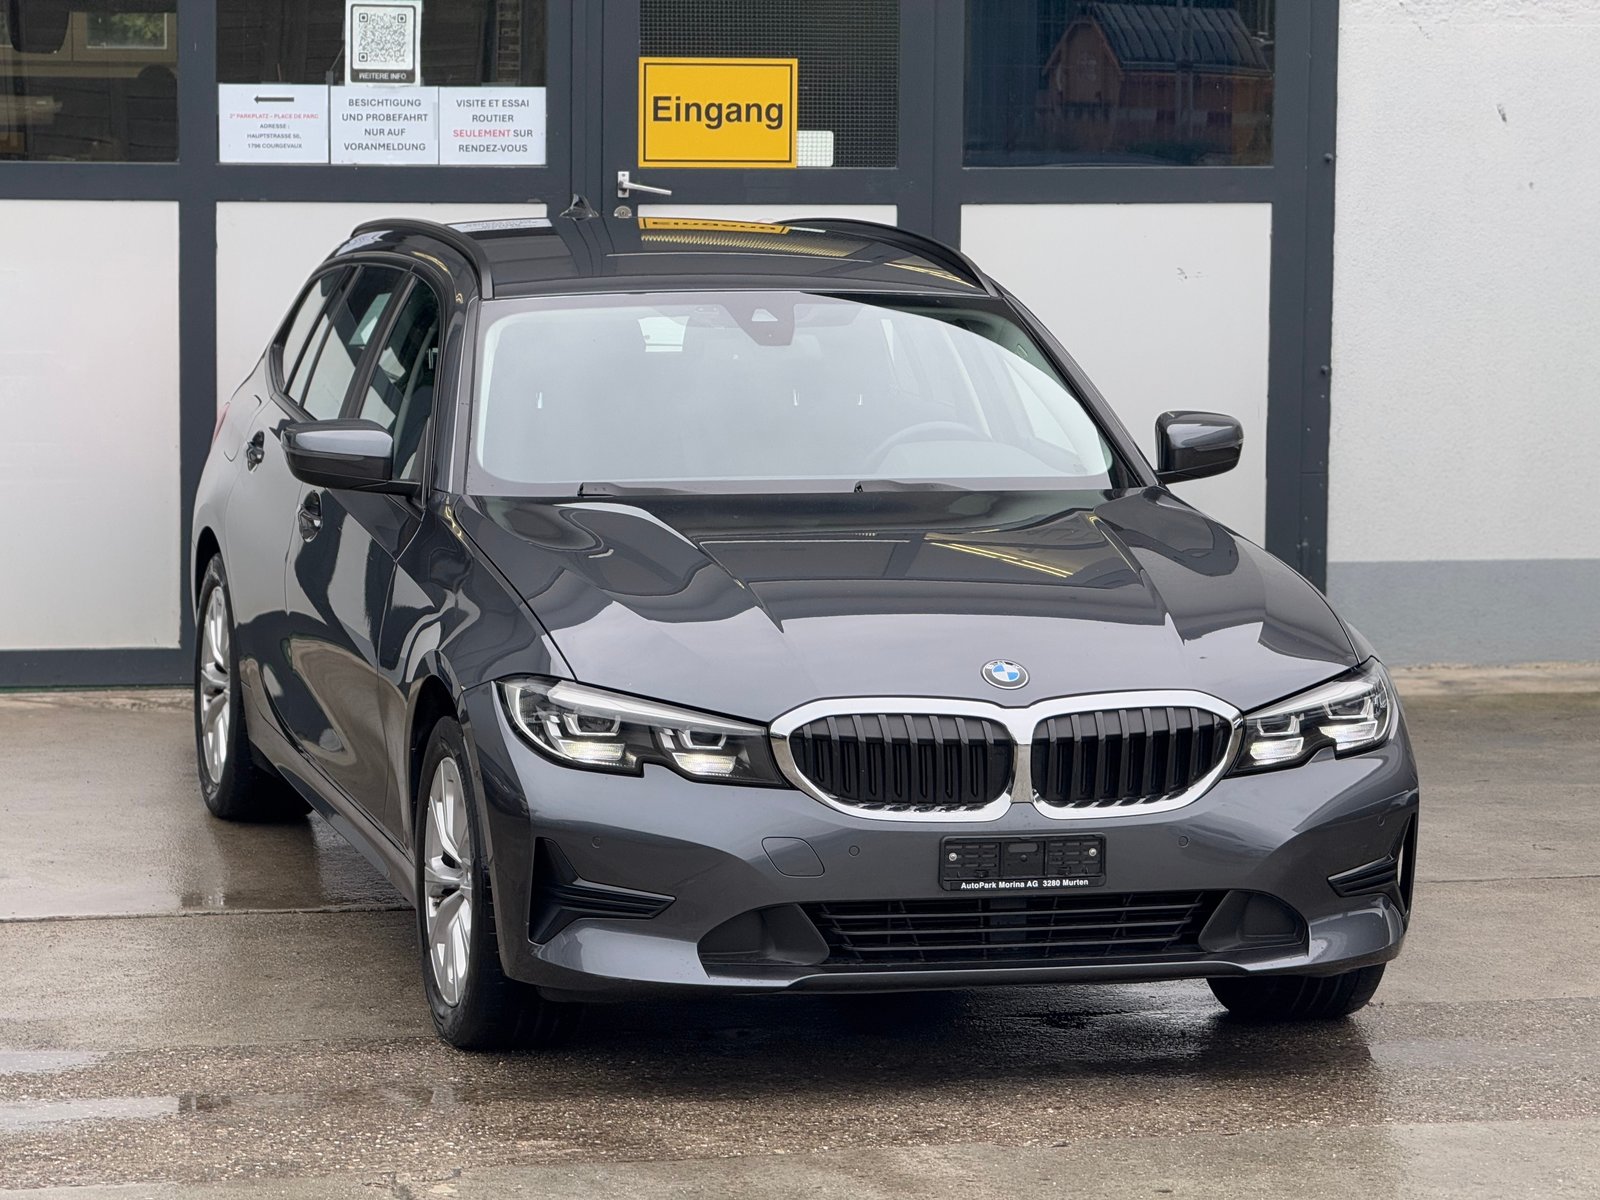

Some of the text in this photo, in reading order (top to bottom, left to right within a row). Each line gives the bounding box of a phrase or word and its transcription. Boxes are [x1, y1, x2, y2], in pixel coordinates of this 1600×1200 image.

[359, 72, 389, 80] WEITERE
[348, 98, 422, 107] BESICHTIGUNG
[456, 99, 529, 107] VISITE ET ESSAI
[652, 96, 783, 130] Eingang
[342, 113, 428, 122] UND PROBEFAHRT
[472, 114, 514, 122] ROUTIER
[364, 128, 406, 136] NUR AUF
[453, 129, 533, 137] SEULEMENT SUR
[344, 142, 426, 151] VORANMELDUNG
[458, 144, 528, 152] RENDEZ-VOUS
